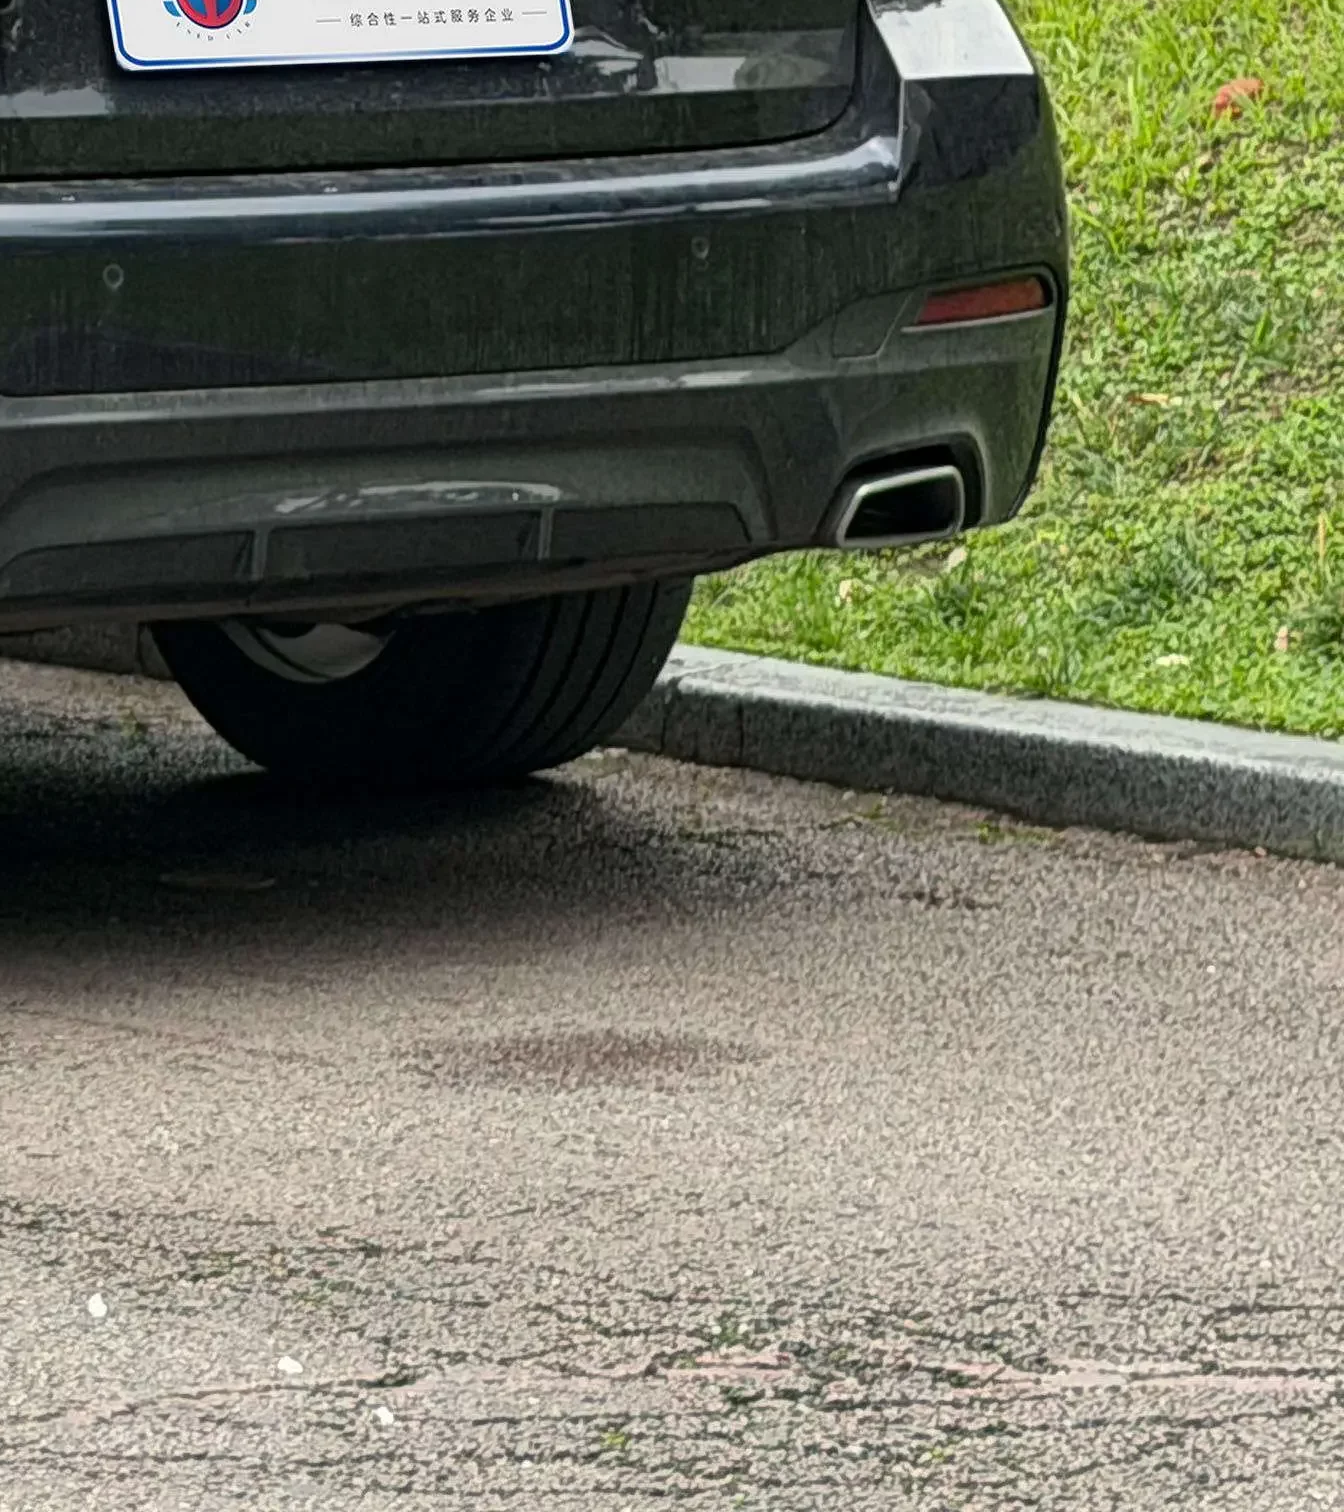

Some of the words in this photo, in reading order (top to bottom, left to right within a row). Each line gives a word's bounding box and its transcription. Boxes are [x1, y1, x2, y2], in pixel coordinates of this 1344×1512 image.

[349, 8, 514, 28] 综合性一站式服务企业
